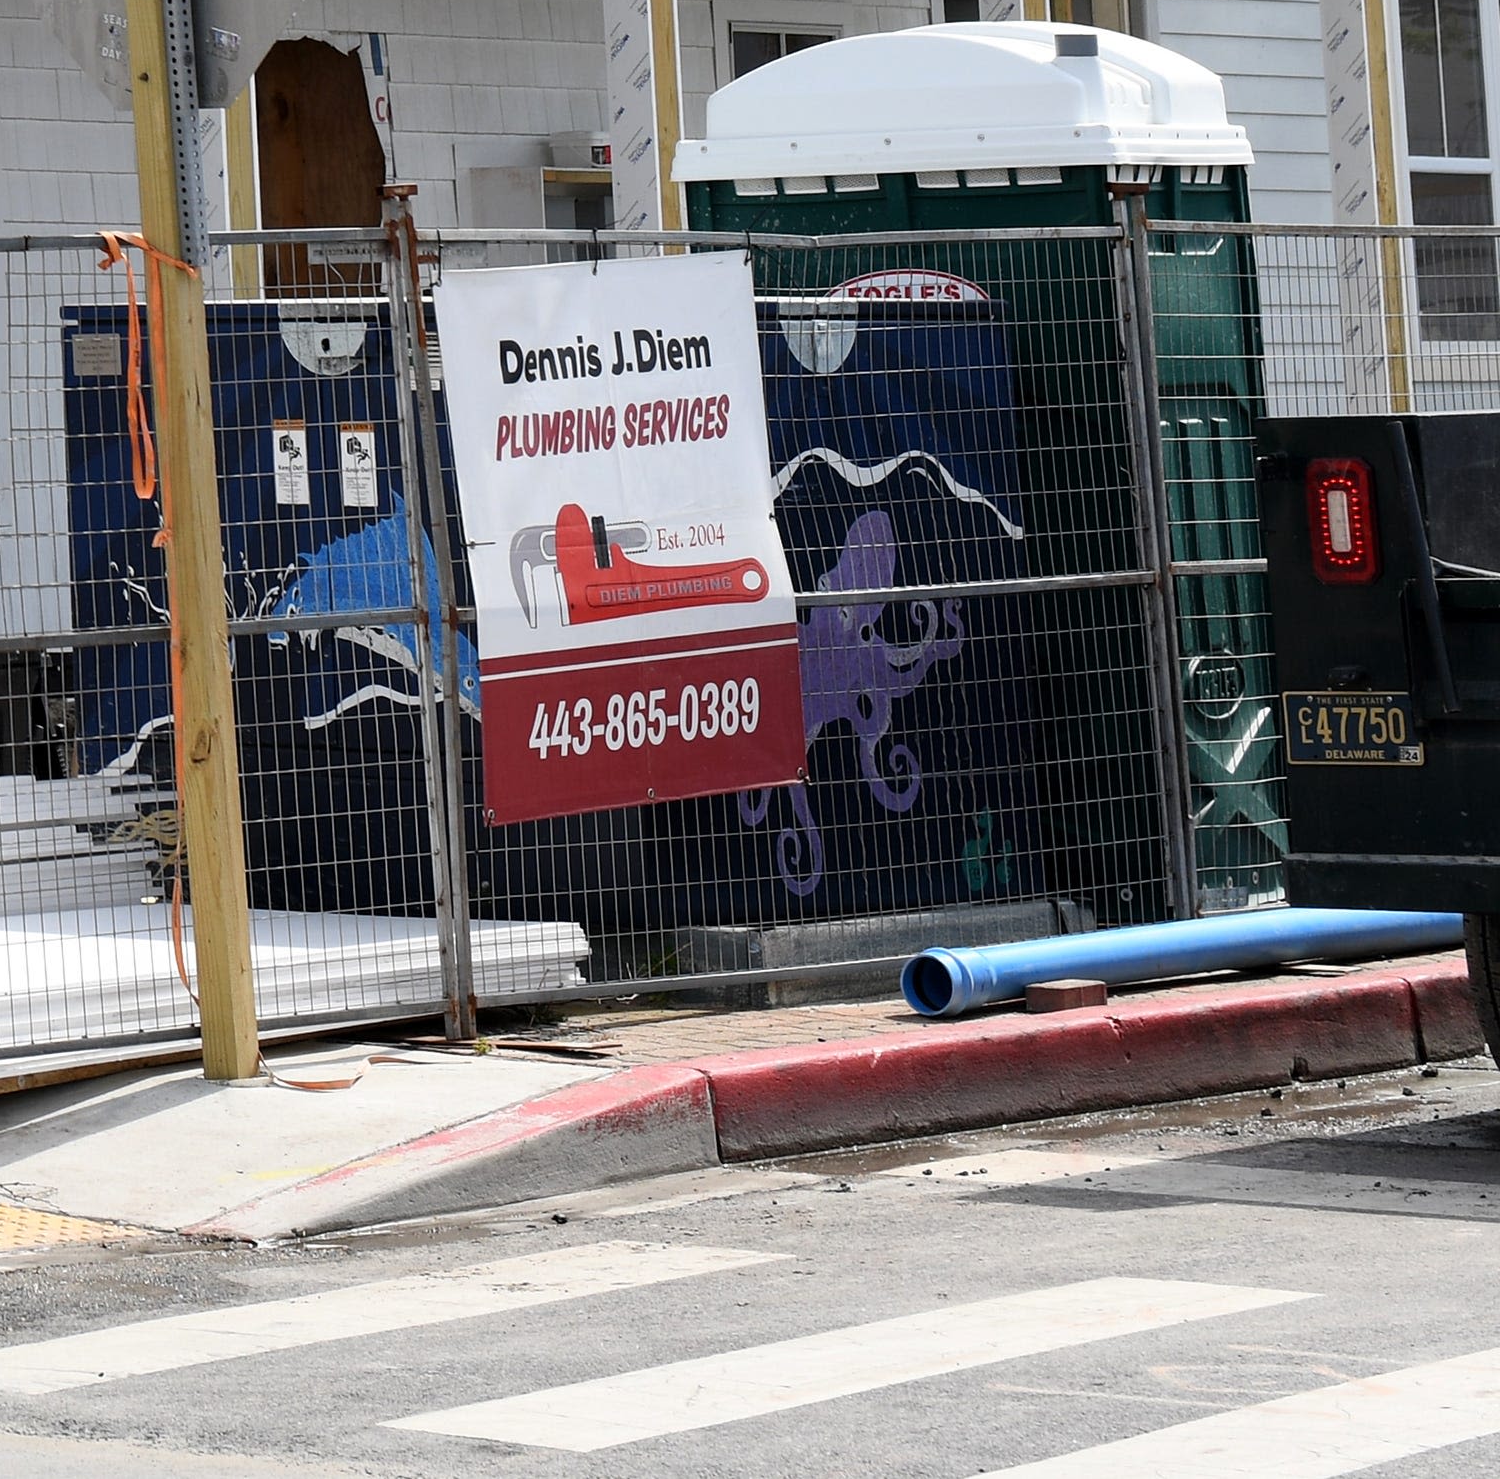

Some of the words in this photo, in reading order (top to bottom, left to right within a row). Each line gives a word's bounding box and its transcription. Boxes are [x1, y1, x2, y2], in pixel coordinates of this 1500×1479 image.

[499, 335, 603, 385] Dennis
[611, 329, 712, 376] J.Diem
[496, 405, 616, 462] PLUMBING
[622, 393, 730, 448] SERVICES
[657, 528, 684, 551] Est.
[689, 522, 725, 548] 2004
[600, 587, 641, 604] DIEM
[647, 575, 733, 600] PLUMBING
[1317, 696, 1333, 705] THE
[1336, 696, 1357, 705] FIRST
[1360, 696, 1384, 705] STATE
[529, 676, 760, 760] 443-865-0389
[1316, 707, 1406, 744] 47750
[1325, 750, 1386, 760] DELAWARE
